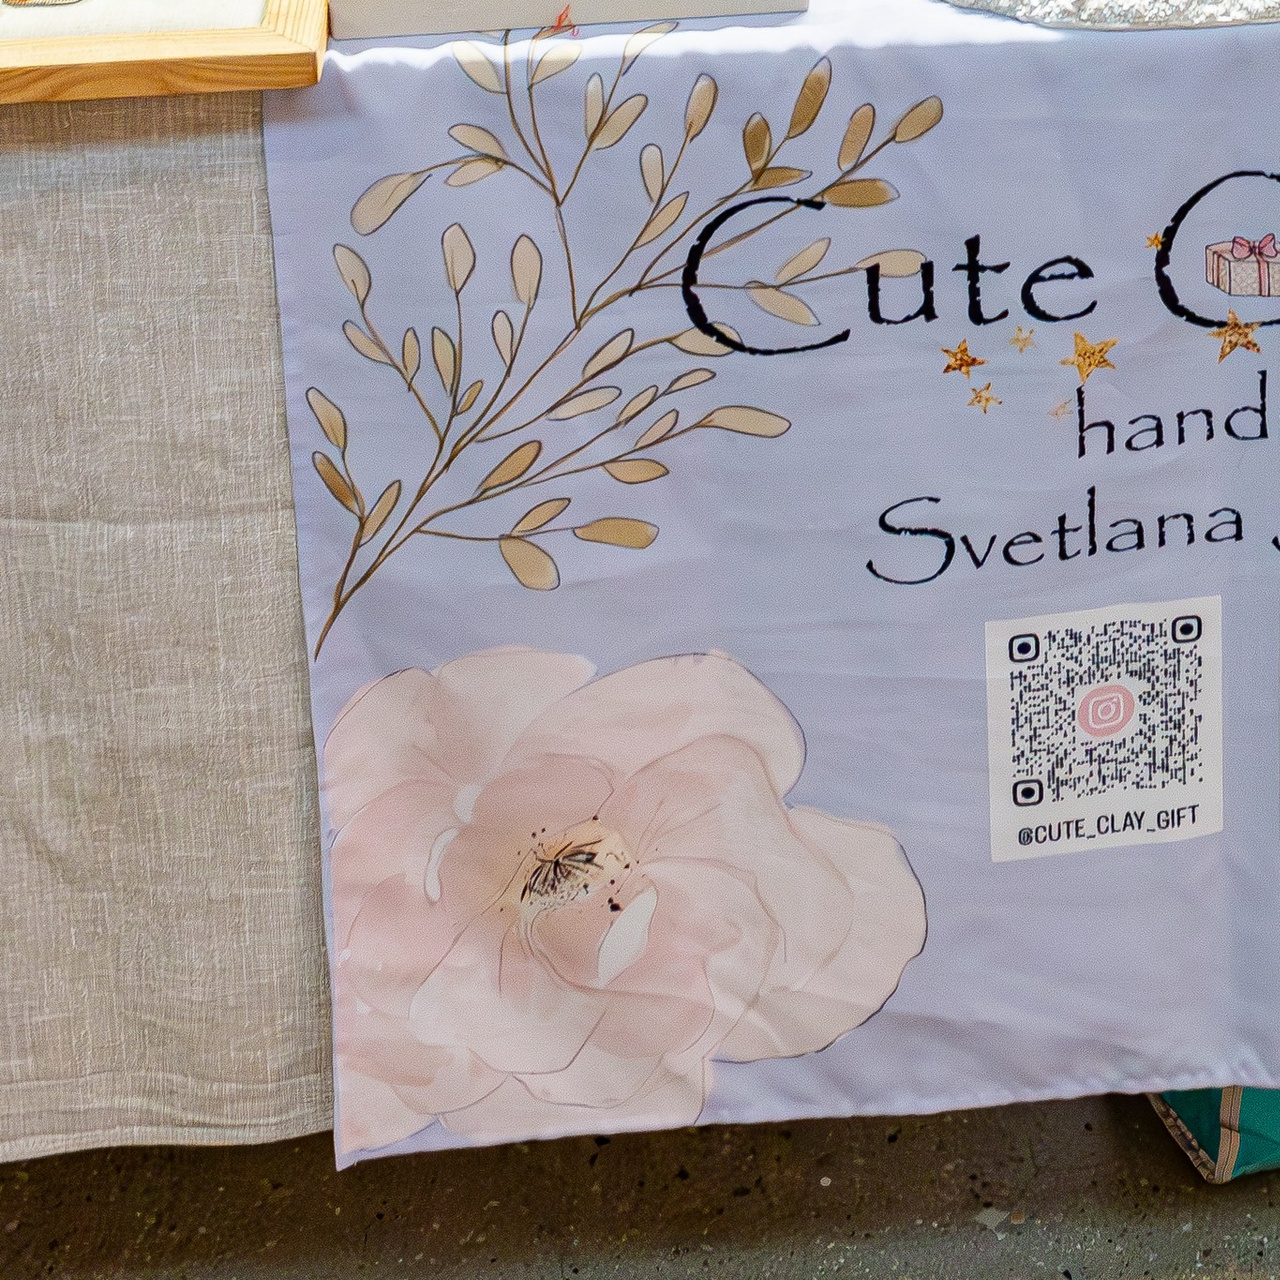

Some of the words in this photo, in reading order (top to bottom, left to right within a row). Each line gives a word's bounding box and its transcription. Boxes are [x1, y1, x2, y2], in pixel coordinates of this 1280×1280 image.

[682, 195, 1098, 357] Cute
[865, 485, 1244, 585] Svetlana
[1018, 803, 1200, 846] @CUTE_CLAY_GIFT
